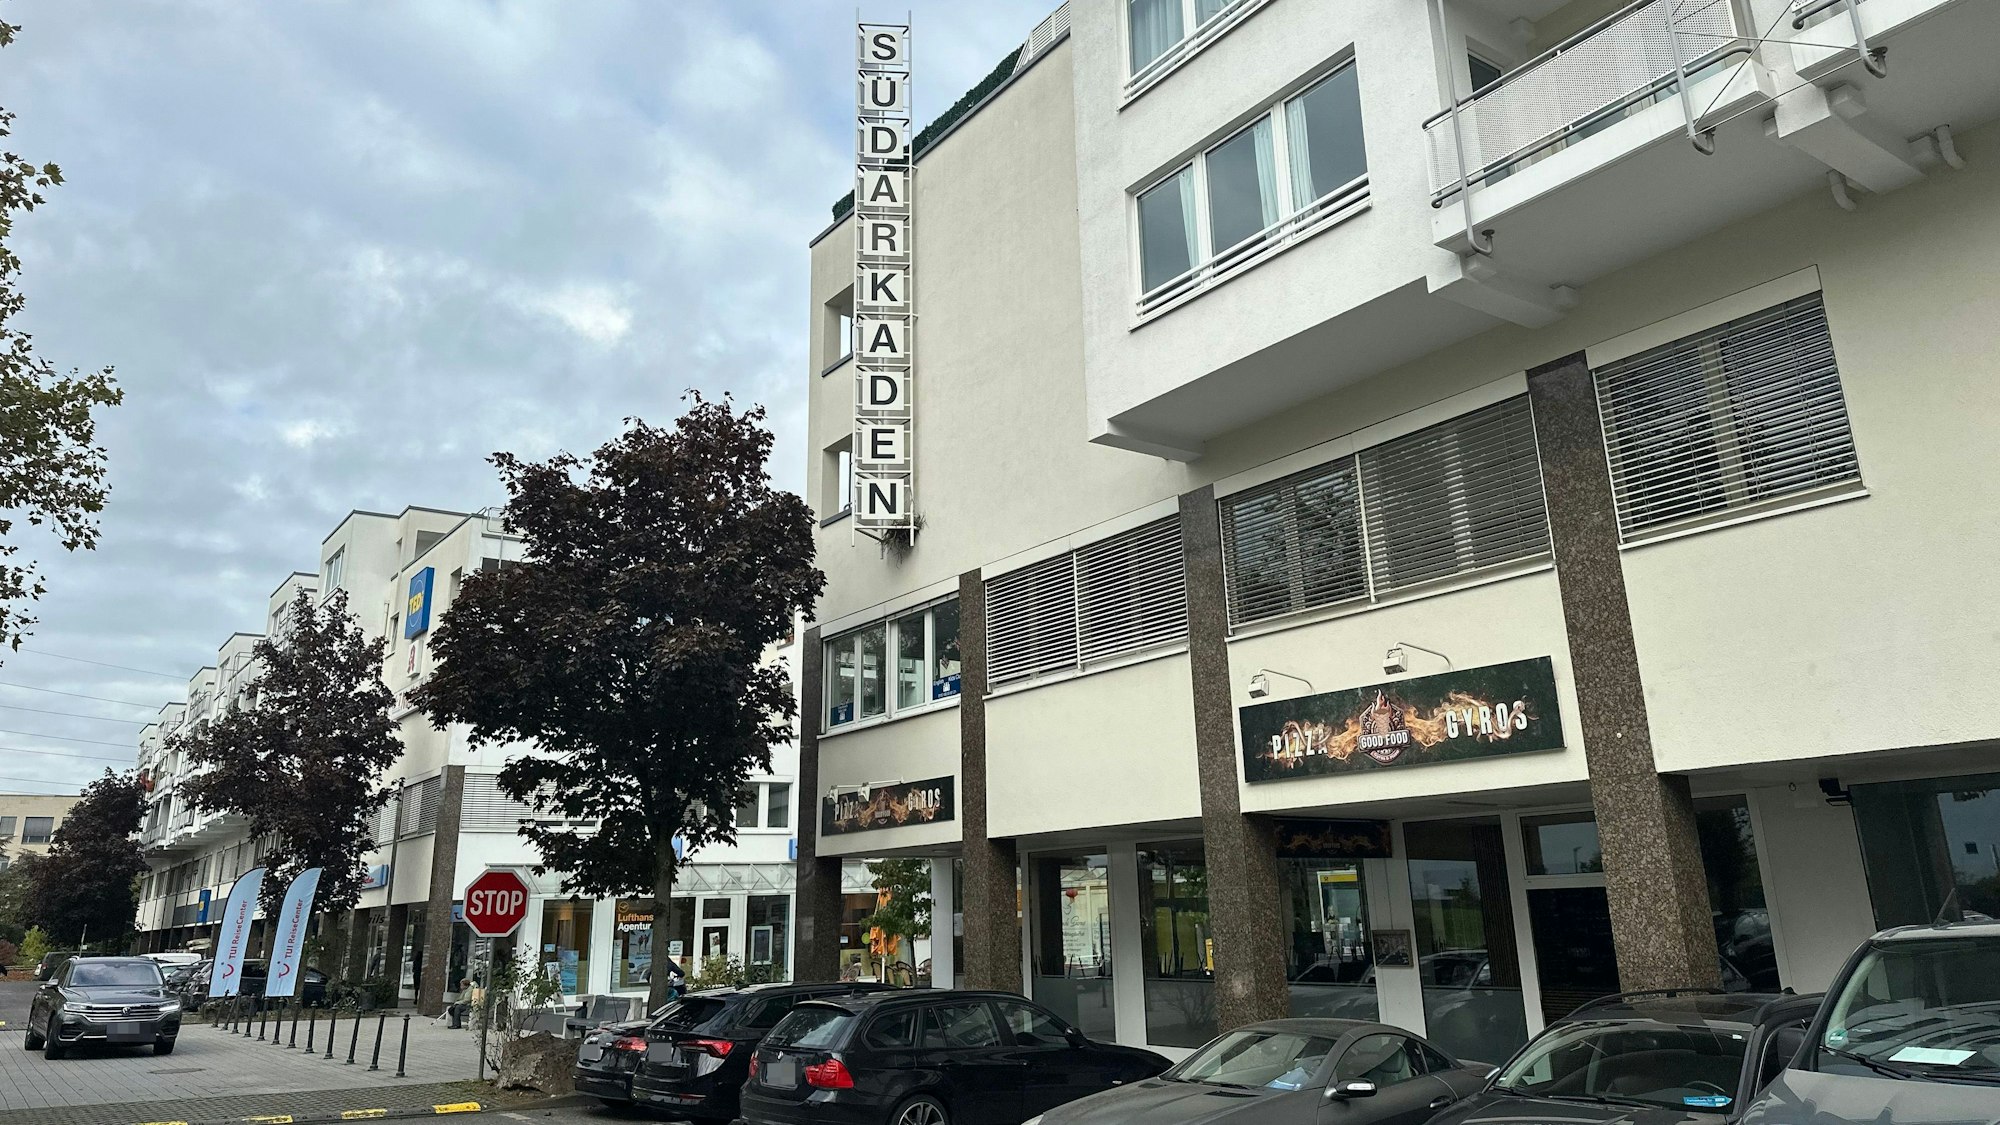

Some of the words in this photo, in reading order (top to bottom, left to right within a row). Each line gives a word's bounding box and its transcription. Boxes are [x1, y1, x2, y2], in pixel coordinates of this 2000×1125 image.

[868, 32, 898, 516] SÜDARKADEN
[1445, 700, 1528, 739] GYROS
[1361, 736, 1384, 749] GOOD
[1385, 731, 1408, 746] FOOD
[469, 889, 524, 916] STOP
[232, 900, 248, 945] ReiseCenter
[287, 899, 304, 944] ReiseCenter
[617, 913, 654, 922] Lufthans
[617, 922, 652, 932] Agentur
[228, 944, 238, 960] TUI
[285, 943, 294, 959] TUI
